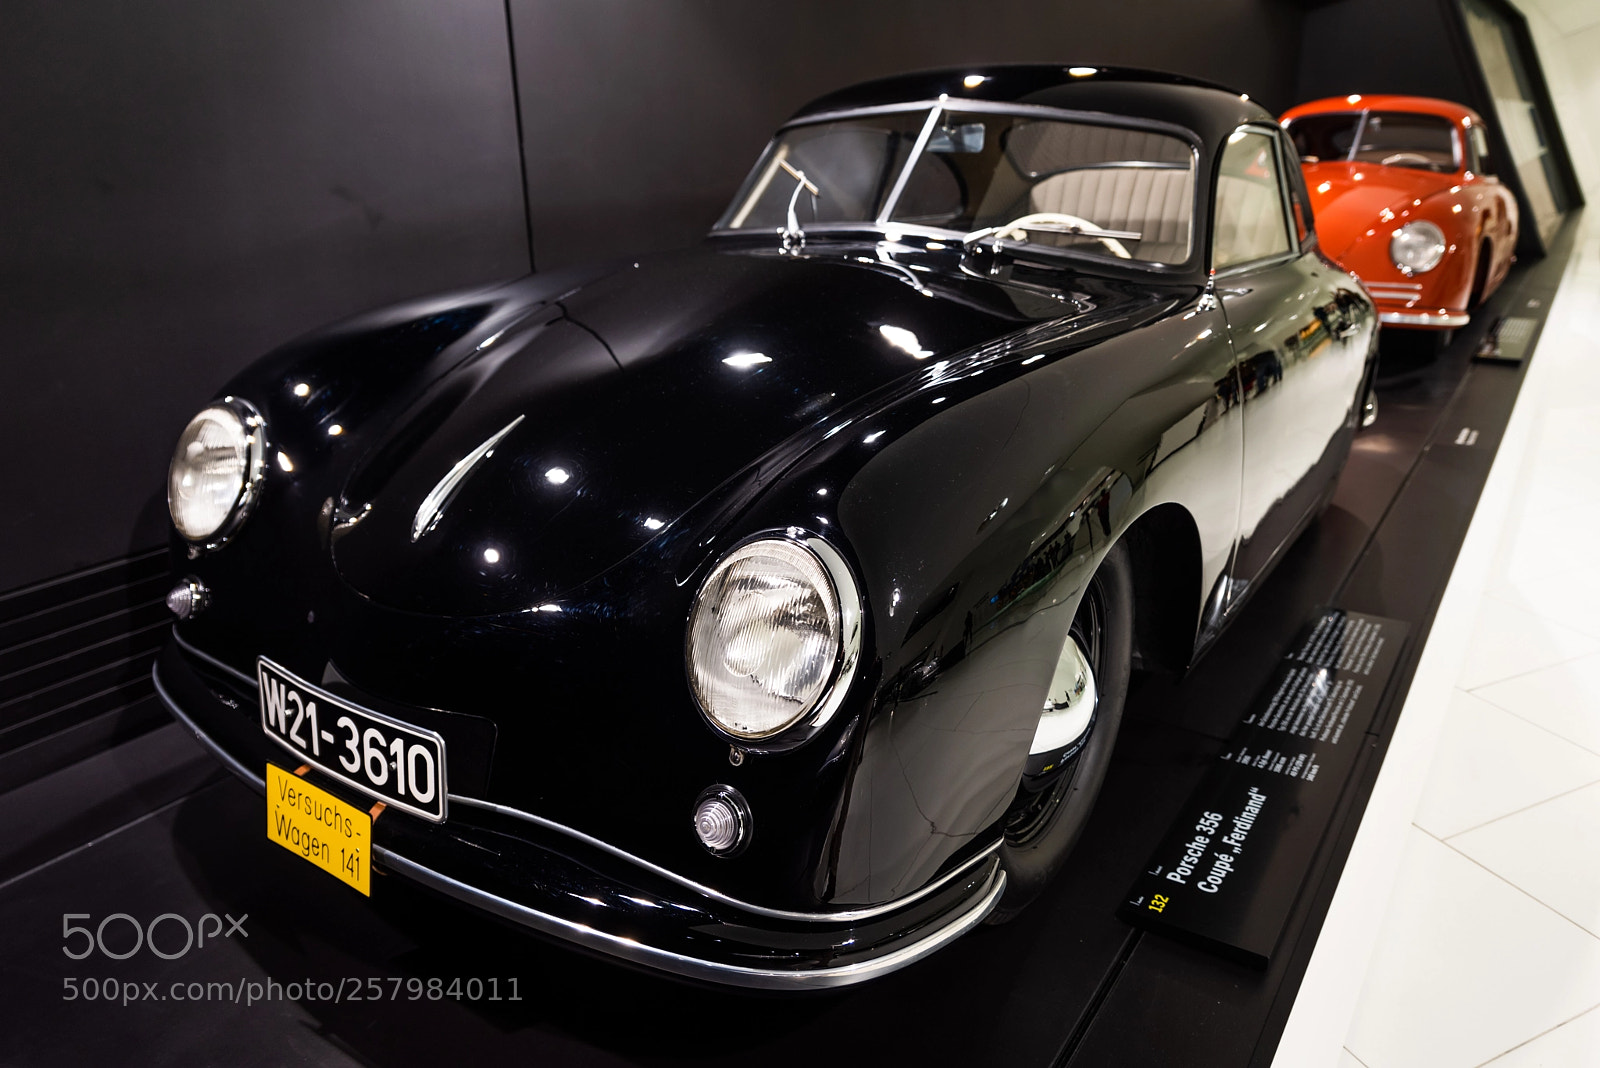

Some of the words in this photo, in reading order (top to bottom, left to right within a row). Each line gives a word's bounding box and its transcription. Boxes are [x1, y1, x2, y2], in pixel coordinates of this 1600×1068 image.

[261, 670, 436, 804] W21-3610
[277, 775, 361, 838] Versuchs-
[275, 810, 330, 864] Wagen
[341, 848, 360, 882] 141
[1166, 835, 1210, 884] Porsche
[1195, 811, 1223, 835] 356
[1197, 852, 1234, 893] Coupé
[1148, 893, 1169, 913] 132
